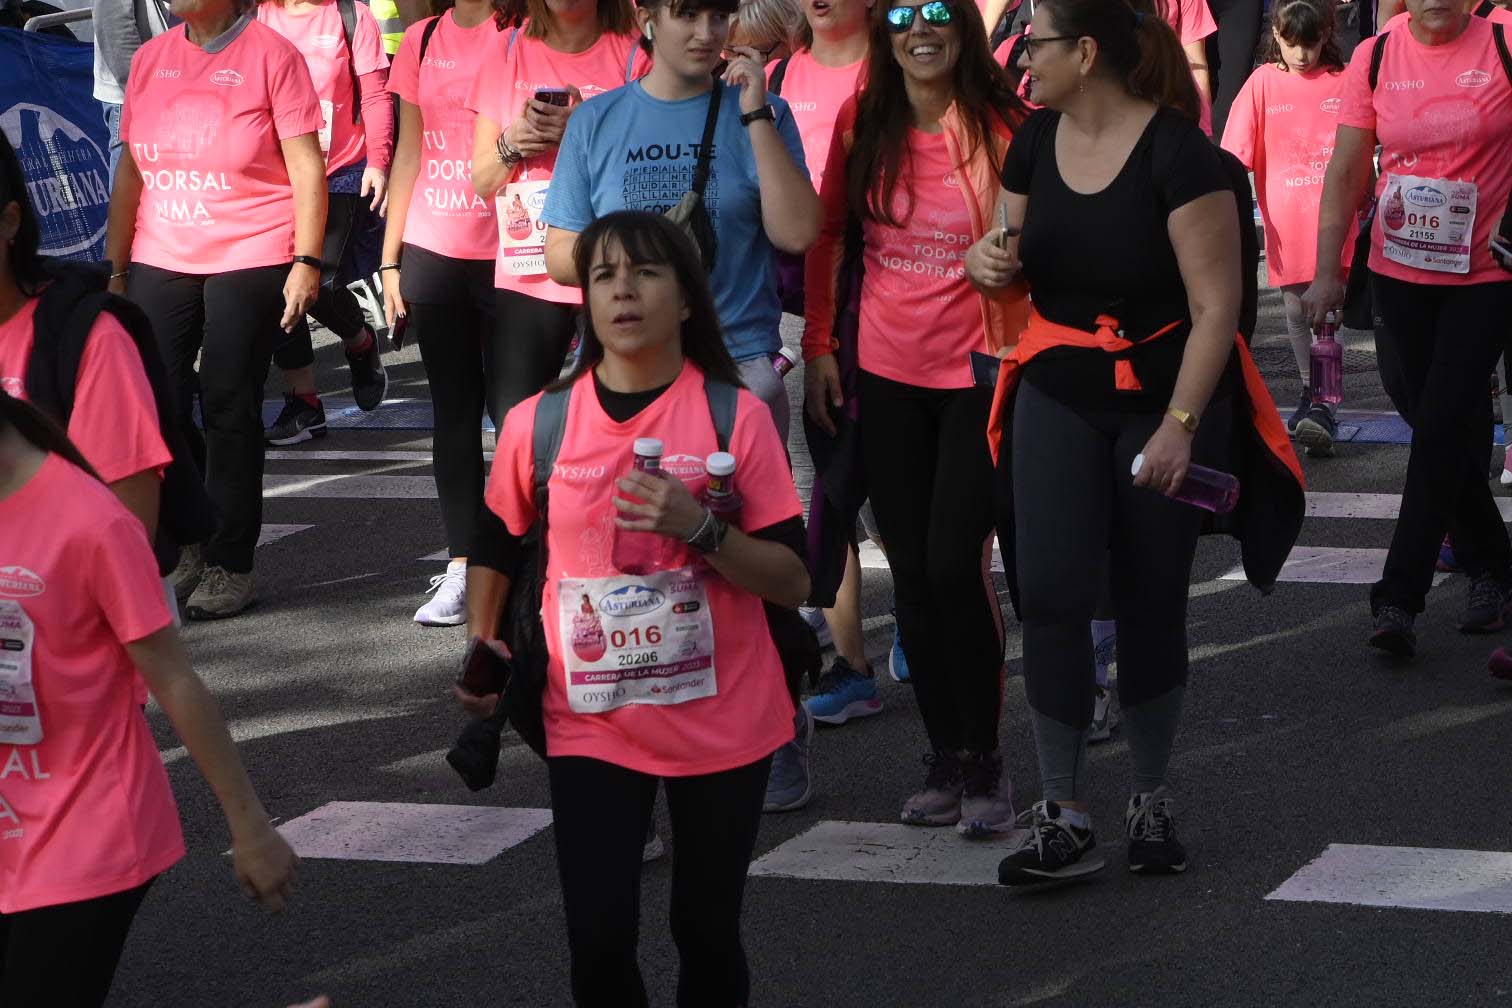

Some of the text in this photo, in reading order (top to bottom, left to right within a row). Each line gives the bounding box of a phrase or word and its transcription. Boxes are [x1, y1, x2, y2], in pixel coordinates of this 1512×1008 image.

[1385, 79, 1424, 91] OYSHO
[424, 129, 445, 151] TU
[427, 159, 473, 182] DORS
[142, 170, 232, 191] DORSAL
[1285, 175, 1325, 188] NOSOT
[424, 187, 488, 210] SUMA
[1408, 193, 1444, 204] ASTURIANA
[1407, 213, 1440, 229] 016
[934, 231, 970, 244] POR
[1409, 230, 1436, 241] 21155
[514, 247, 543, 255] CARRERA
[879, 255, 966, 279] NOSOTRAS
[604, 596, 661, 611] ASTURIANA
[611, 625, 662, 649] 016
[618, 651, 658, 666] 20206
[584, 672, 622, 682] CARRERA
[638, 668, 650, 677] LA
[651, 665, 679, 676] MUJER
[663, 678, 705, 695] Santander
[583, 687, 626, 704] OYSHO
